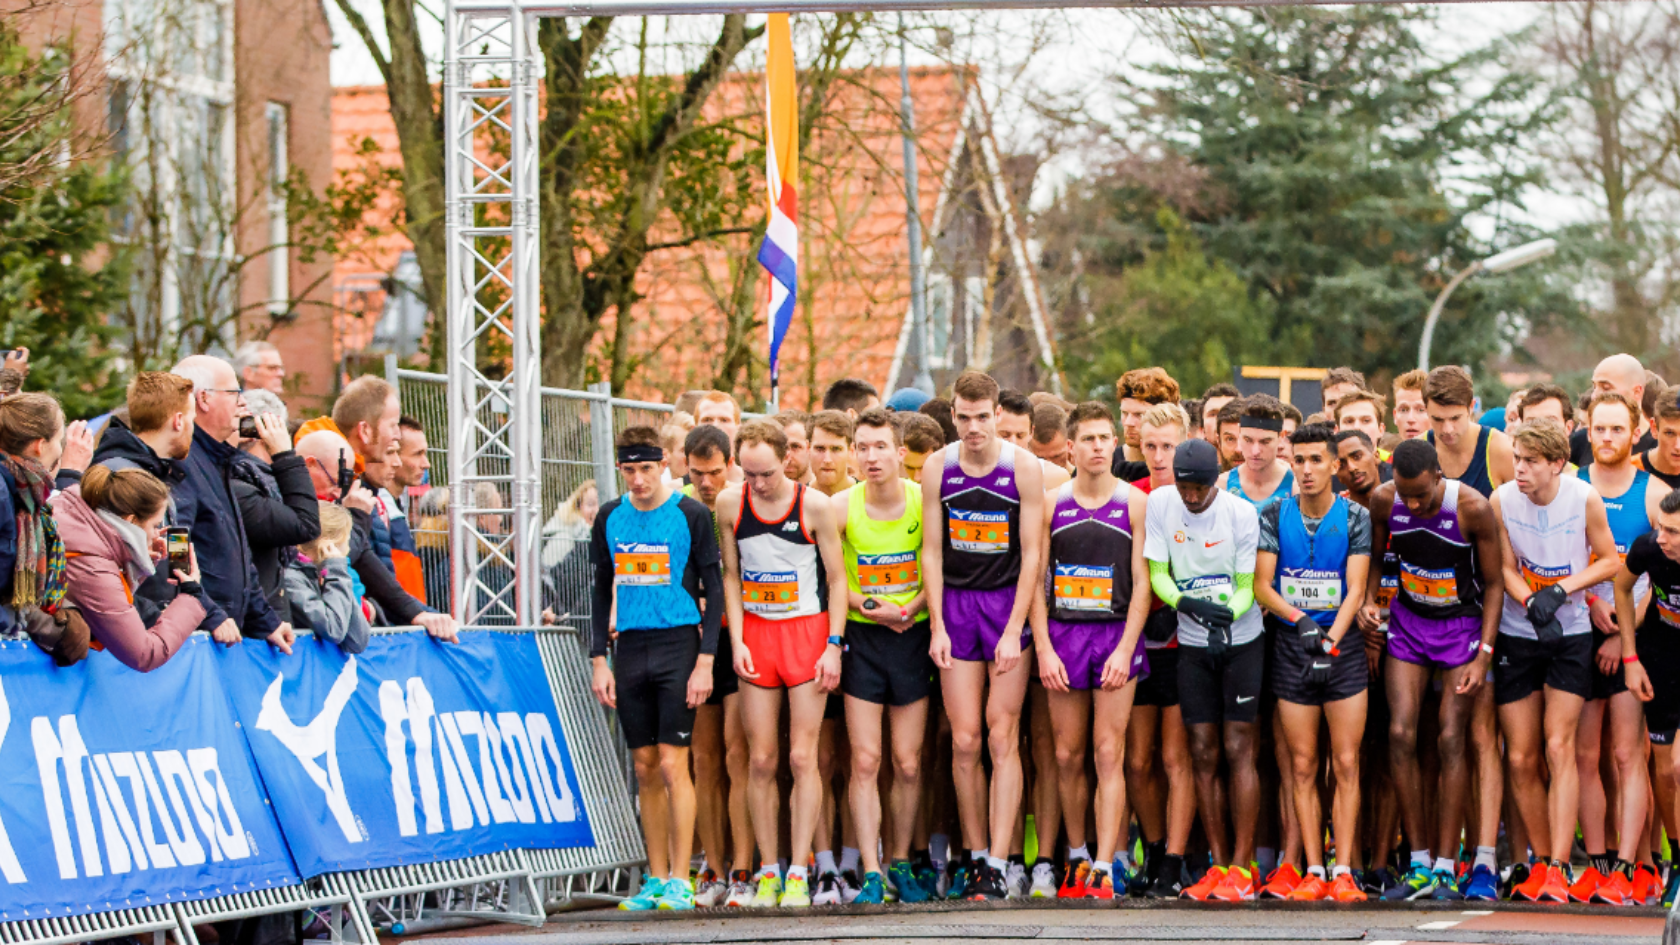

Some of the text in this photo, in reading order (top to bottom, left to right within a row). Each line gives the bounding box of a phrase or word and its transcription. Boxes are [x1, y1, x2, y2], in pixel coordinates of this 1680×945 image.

[975, 529, 981, 541] 2
[637, 562, 647, 573] 10
[885, 572, 891, 584] 5
[764, 591, 775, 601] 23
[1301, 587, 1318, 598] 104
